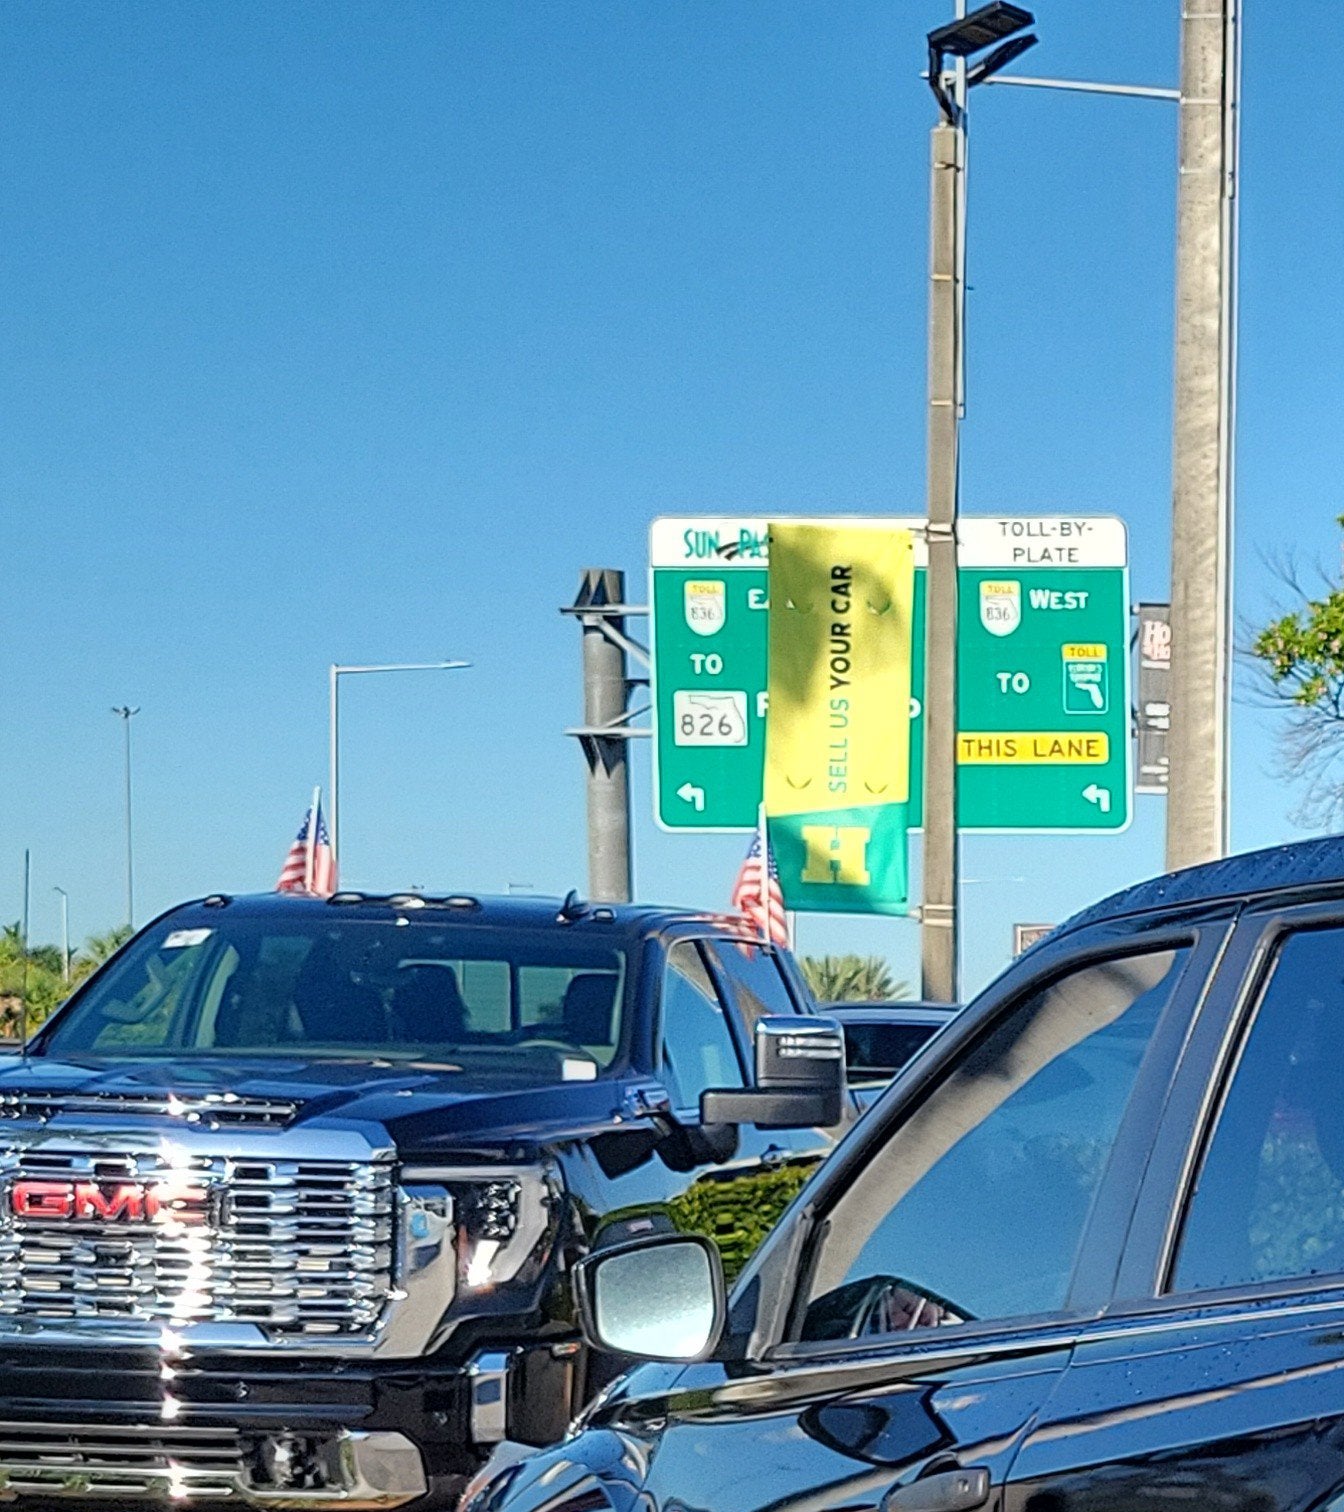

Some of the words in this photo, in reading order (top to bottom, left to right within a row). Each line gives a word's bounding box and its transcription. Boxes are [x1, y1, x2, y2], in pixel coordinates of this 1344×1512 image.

[999, 521, 1094, 537] TOLL-BY-
[684, 527, 720, 558] SUN
[1013, 547, 1080, 563] PLATE
[831, 564, 853, 614] CAR
[1028, 588, 1090, 610] WEST
[691, 606, 716, 621] 836
[986, 606, 1011, 621] 836
[830, 622, 852, 690] YOUR
[1070, 646, 1102, 658] TOLL
[690, 653, 724, 675] TO
[996, 672, 1031, 694] TO
[830, 697, 850, 729] US
[680, 713, 733, 736] 826
[962, 738, 1018, 758] THIS
[1033, 738, 1101, 758] LANE
[828, 738, 849, 793] SELL
[12, 1181, 208, 1222] GMC
